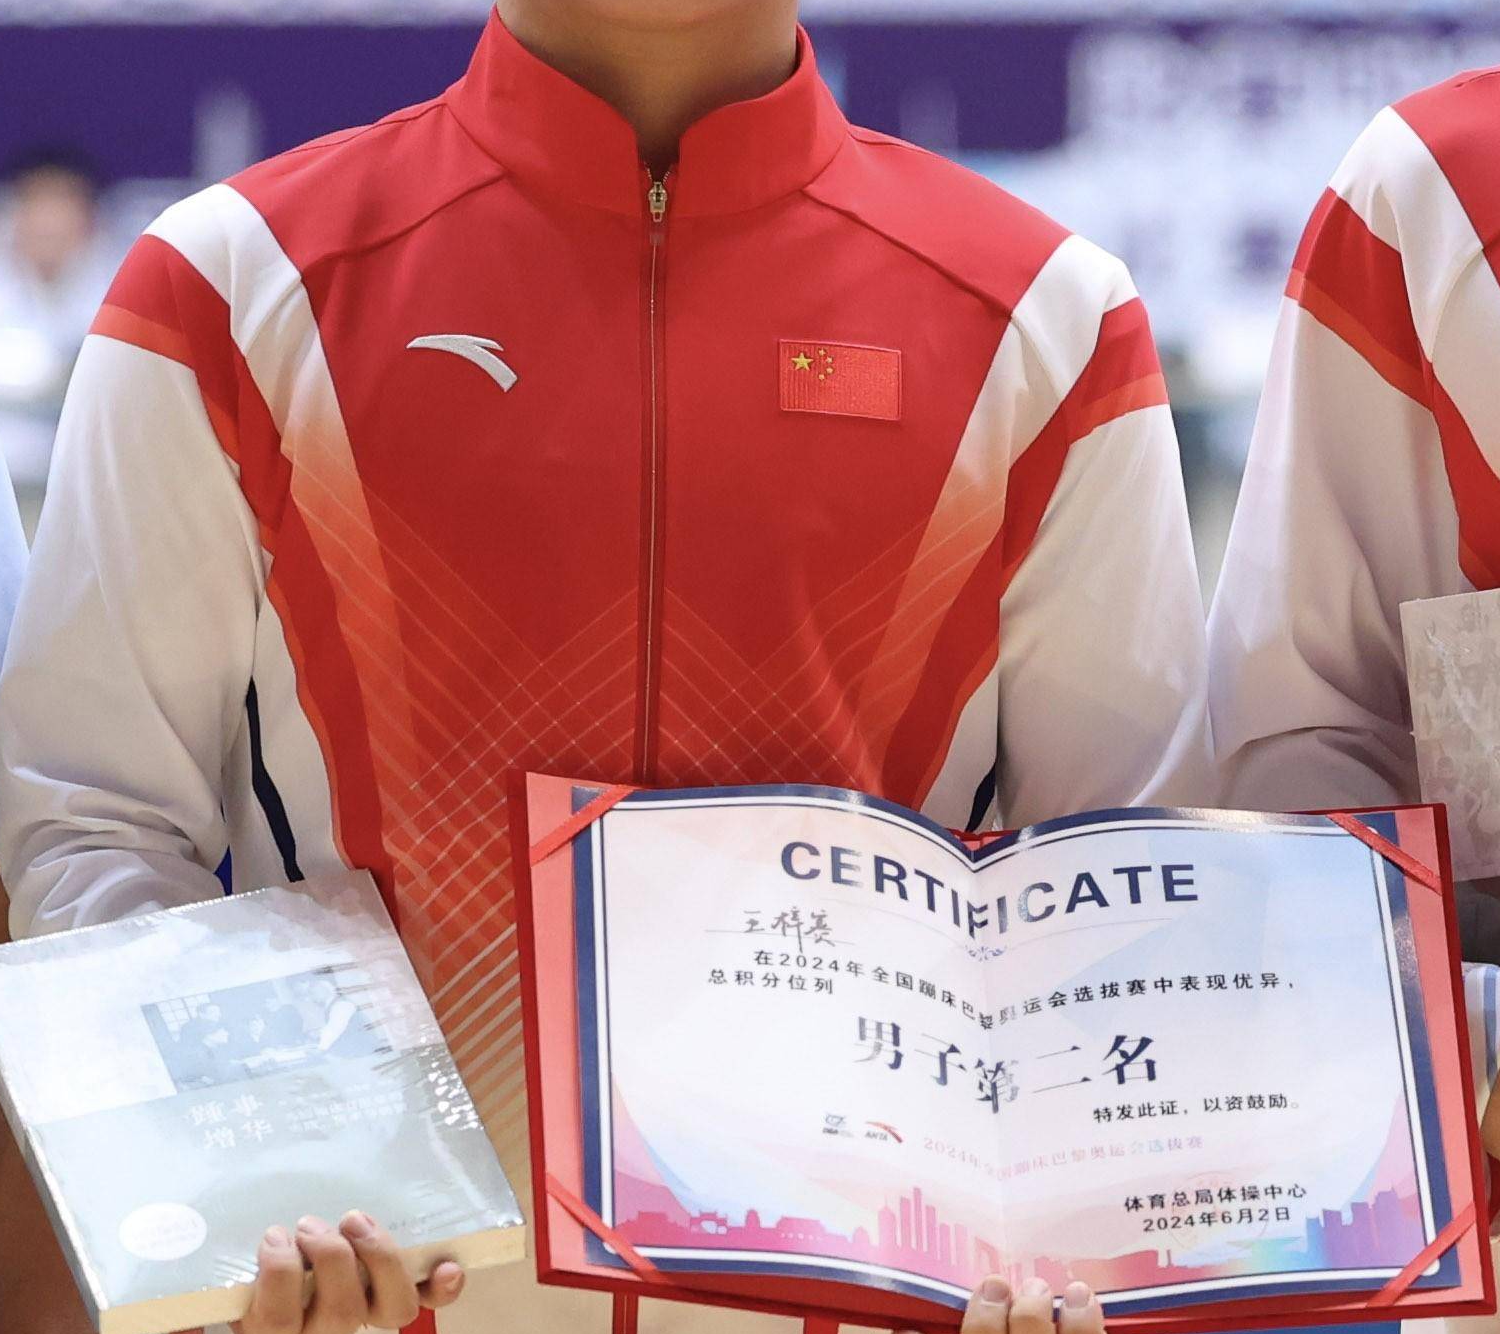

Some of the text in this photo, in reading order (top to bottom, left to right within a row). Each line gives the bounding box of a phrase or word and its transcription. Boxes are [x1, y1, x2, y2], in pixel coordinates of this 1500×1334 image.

[781, 841, 1198, 939] CERTIFICATE
[708, 969, 833, 994] 总积分位列
[853, 1017, 1156, 1114] 男子第二名
[1124, 1184, 1306, 1213] 体育总局体操中心
[1143, 1207, 1290, 1232] 2024年6月2日
